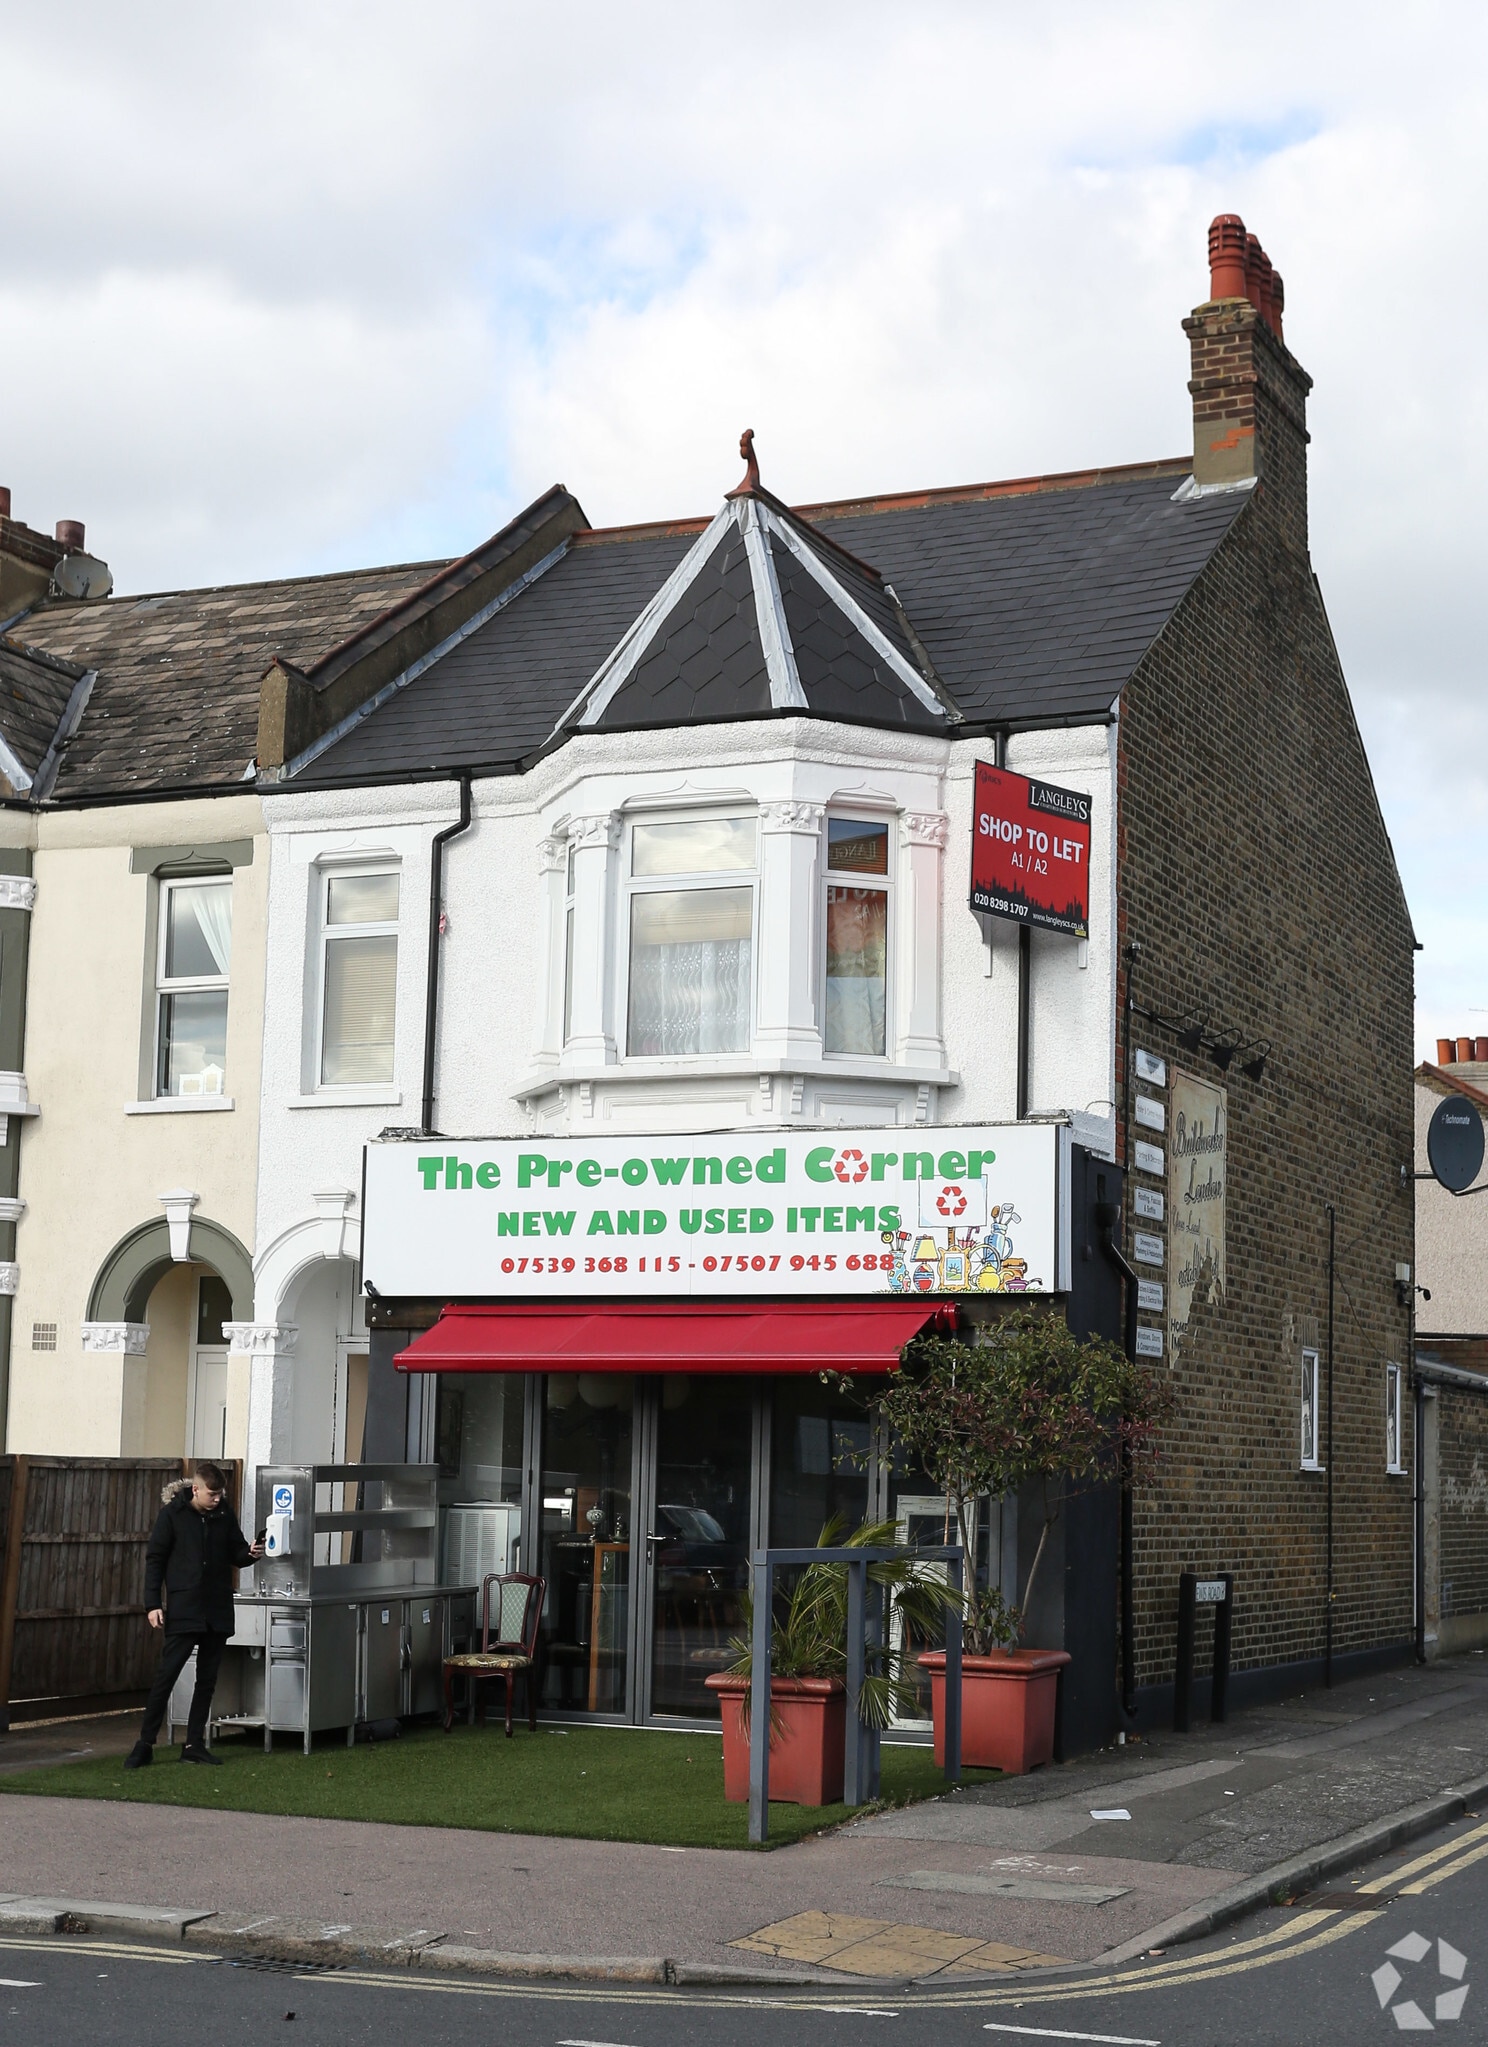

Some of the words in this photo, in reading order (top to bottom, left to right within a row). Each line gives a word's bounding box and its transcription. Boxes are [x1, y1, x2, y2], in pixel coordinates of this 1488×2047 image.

[1031, 786, 1088, 820] LANGLEYS
[979, 813, 1022, 845] SHOP
[1026, 828, 1049, 854] TO
[1053, 836, 1084, 863] LET
[1011, 851, 1024, 868] A1
[1026, 856, 1032, 872] /
[1034, 858, 1048, 875] A2
[974, 892, 989, 906] 020
[990, 895, 1009, 912] 8298
[1010, 900, 1028, 917] 1707
[1033, 913, 1085, 931] www.langleyscs.co.uk
[417, 1156, 501, 1190] The
[517, 1148, 787, 1189] Pre-owned
[1184, 1158, 1223, 1205] London
[497, 1211, 577, 1237] NEW
[587, 1209, 668, 1236] AND
[679, 1208, 774, 1235] USED
[787, 1205, 900, 1233] ITEMS
[501, 1257, 576, 1274] 07539
[584, 1256, 628, 1273] 368
[639, 1256, 681, 1273] 115
[703, 1255, 781, 1273] 07507
[789, 1254, 837, 1271] 945
[846, 1254, 896, 1271] 688
[1170, 1318, 1189, 1334] HOME
[1196, 1586, 1207, 1600] EWIS
